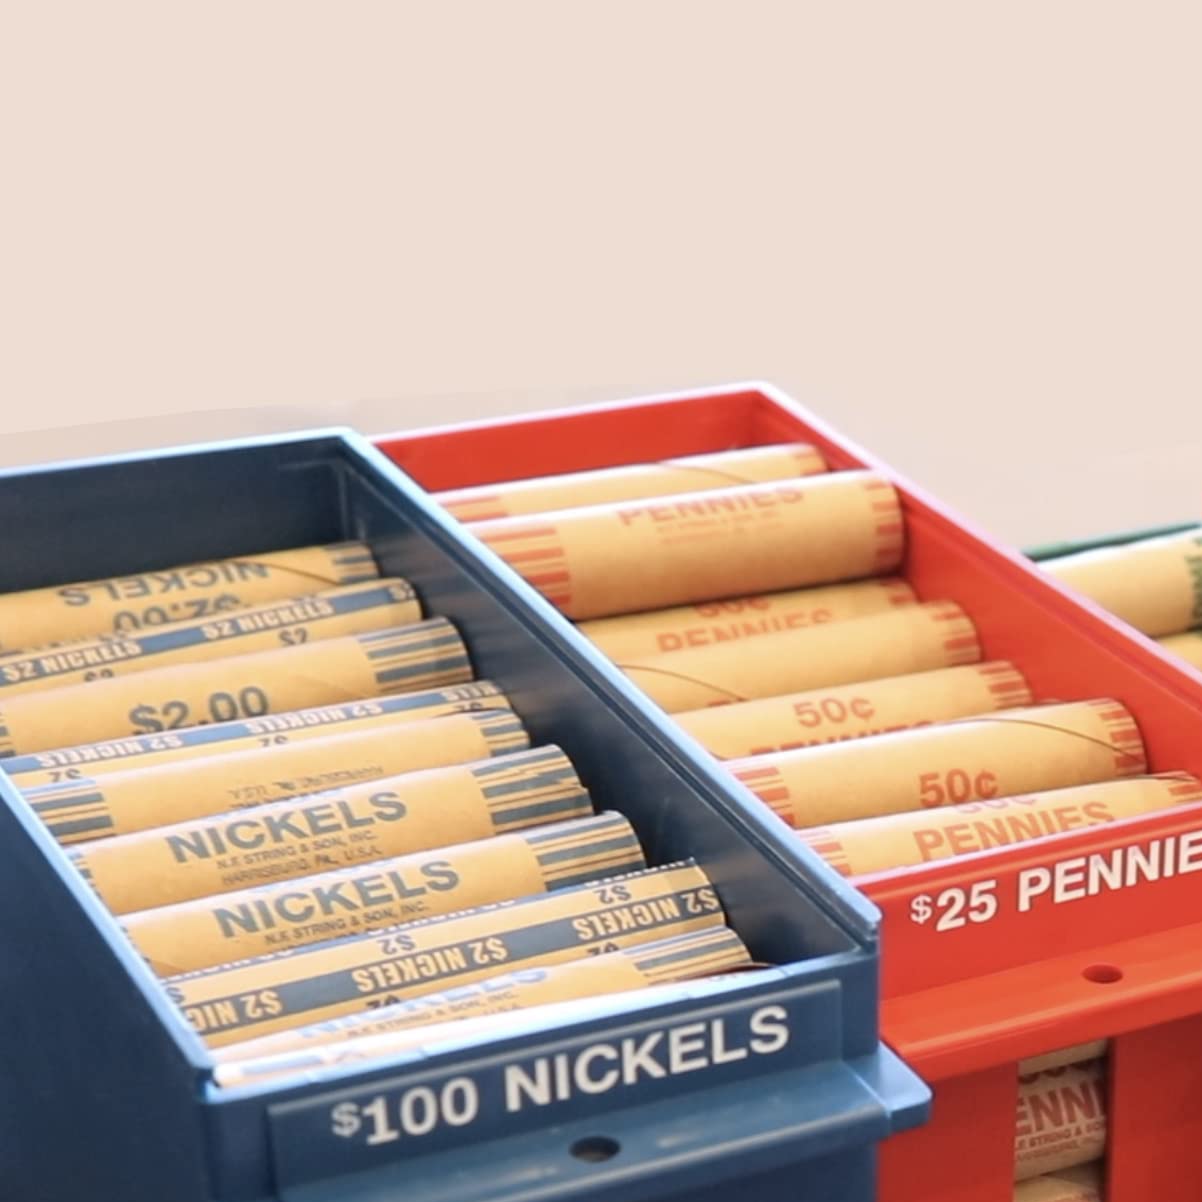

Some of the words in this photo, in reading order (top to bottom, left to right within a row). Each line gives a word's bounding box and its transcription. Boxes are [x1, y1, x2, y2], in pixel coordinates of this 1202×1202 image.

[129, 686, 269, 737] $2.00
[919, 768, 998, 808] 50¢
[165, 791, 408, 864] NICKELS
[213, 860, 460, 938] NICKELS
[571, 896, 682, 942] NICKELS
[910, 882, 998, 931] $25
[351, 948, 467, 993] NICKELS
[468, 937, 509, 963] $2
[241, 989, 284, 1016] $2
[331, 1077, 479, 1146] $100
[504, 1004, 791, 1112] NICKELS
